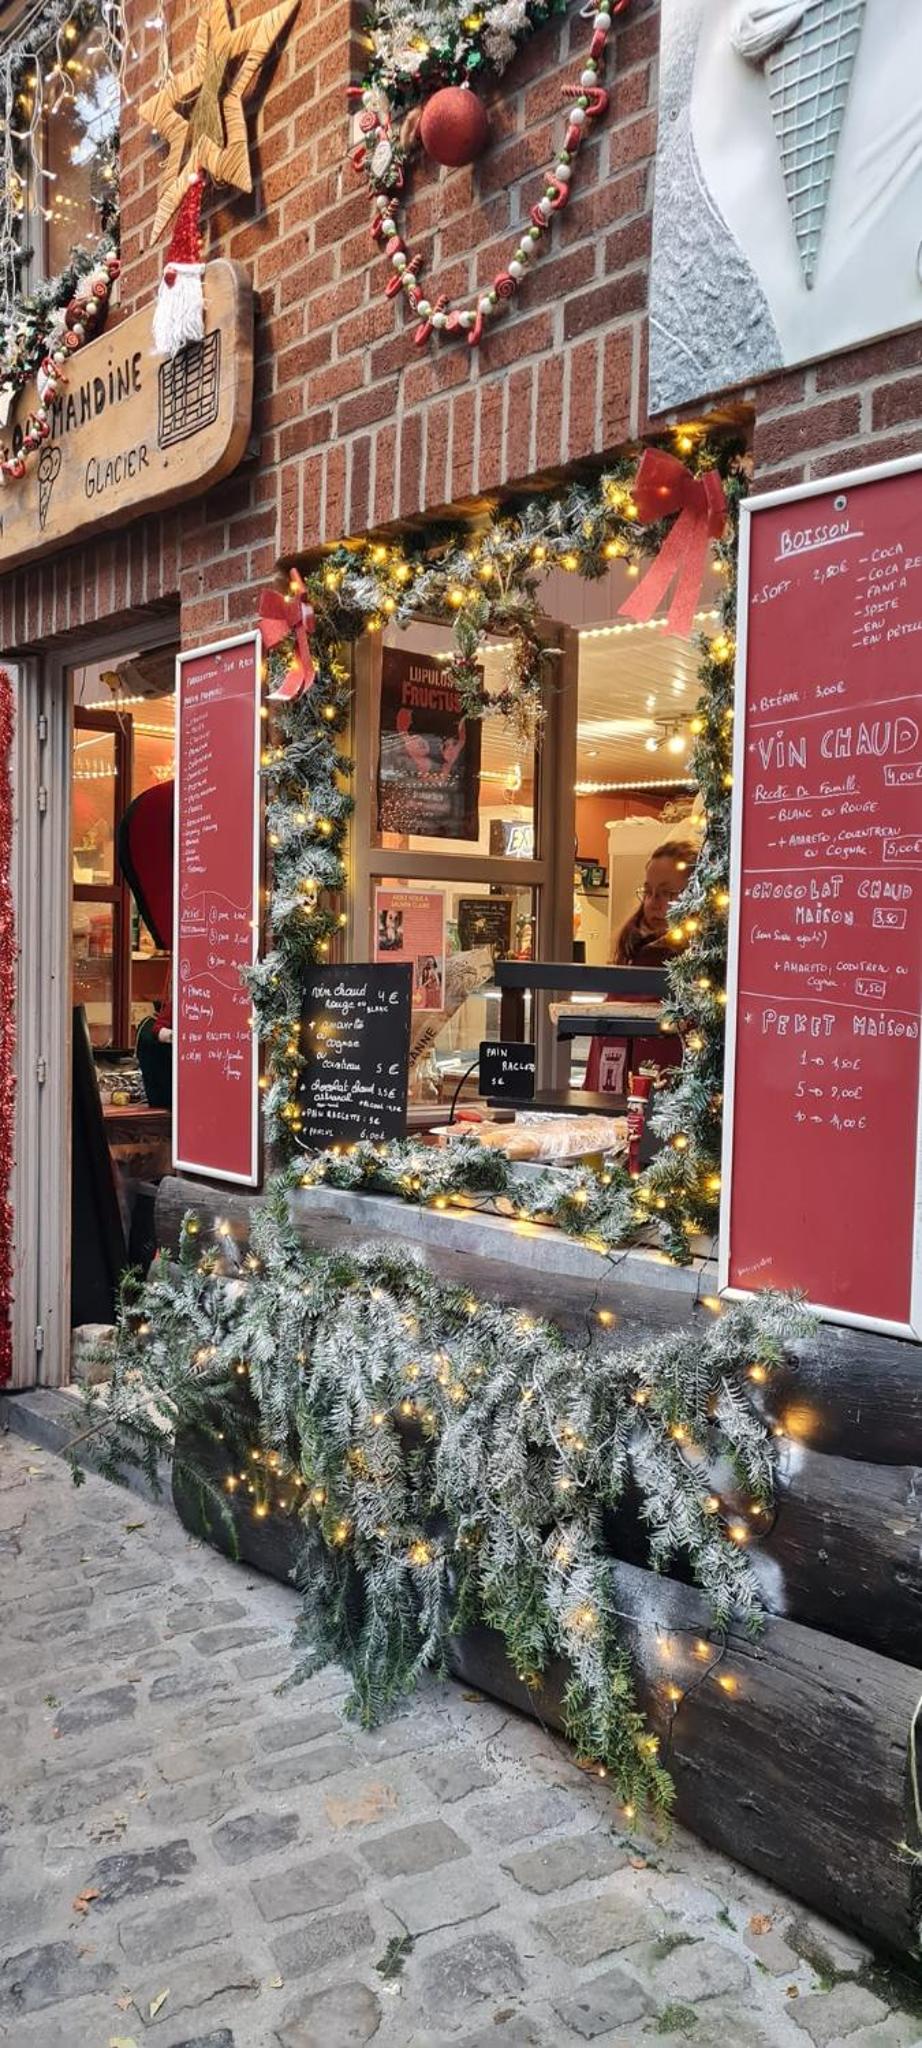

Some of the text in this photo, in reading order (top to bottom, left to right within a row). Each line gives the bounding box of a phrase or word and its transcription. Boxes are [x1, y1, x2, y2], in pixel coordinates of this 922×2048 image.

[85, 446, 149, 498] GLACIER
[780, 521, 850, 554] BOISSON
[871, 543, 903, 563] COCA
[868, 564, 899, 582] COCA
[864, 619, 885, 632] EAU
[863, 634, 882, 646] EAU
[820, 717, 919, 757] CHAUD
[779, 808, 812, 821] BLANC
[841, 801, 880, 816] ROUGE
[752, 875, 913, 901] CHOCOLAT CHAUD
[377, 991, 386, 1003] 4
[389, 992, 400, 1005] €
[762, 1008, 836, 1037] PEKET
[486, 1048, 508, 1057] PAIN
[376, 1063, 384, 1075] 5
[388, 1063, 399, 1076] €
